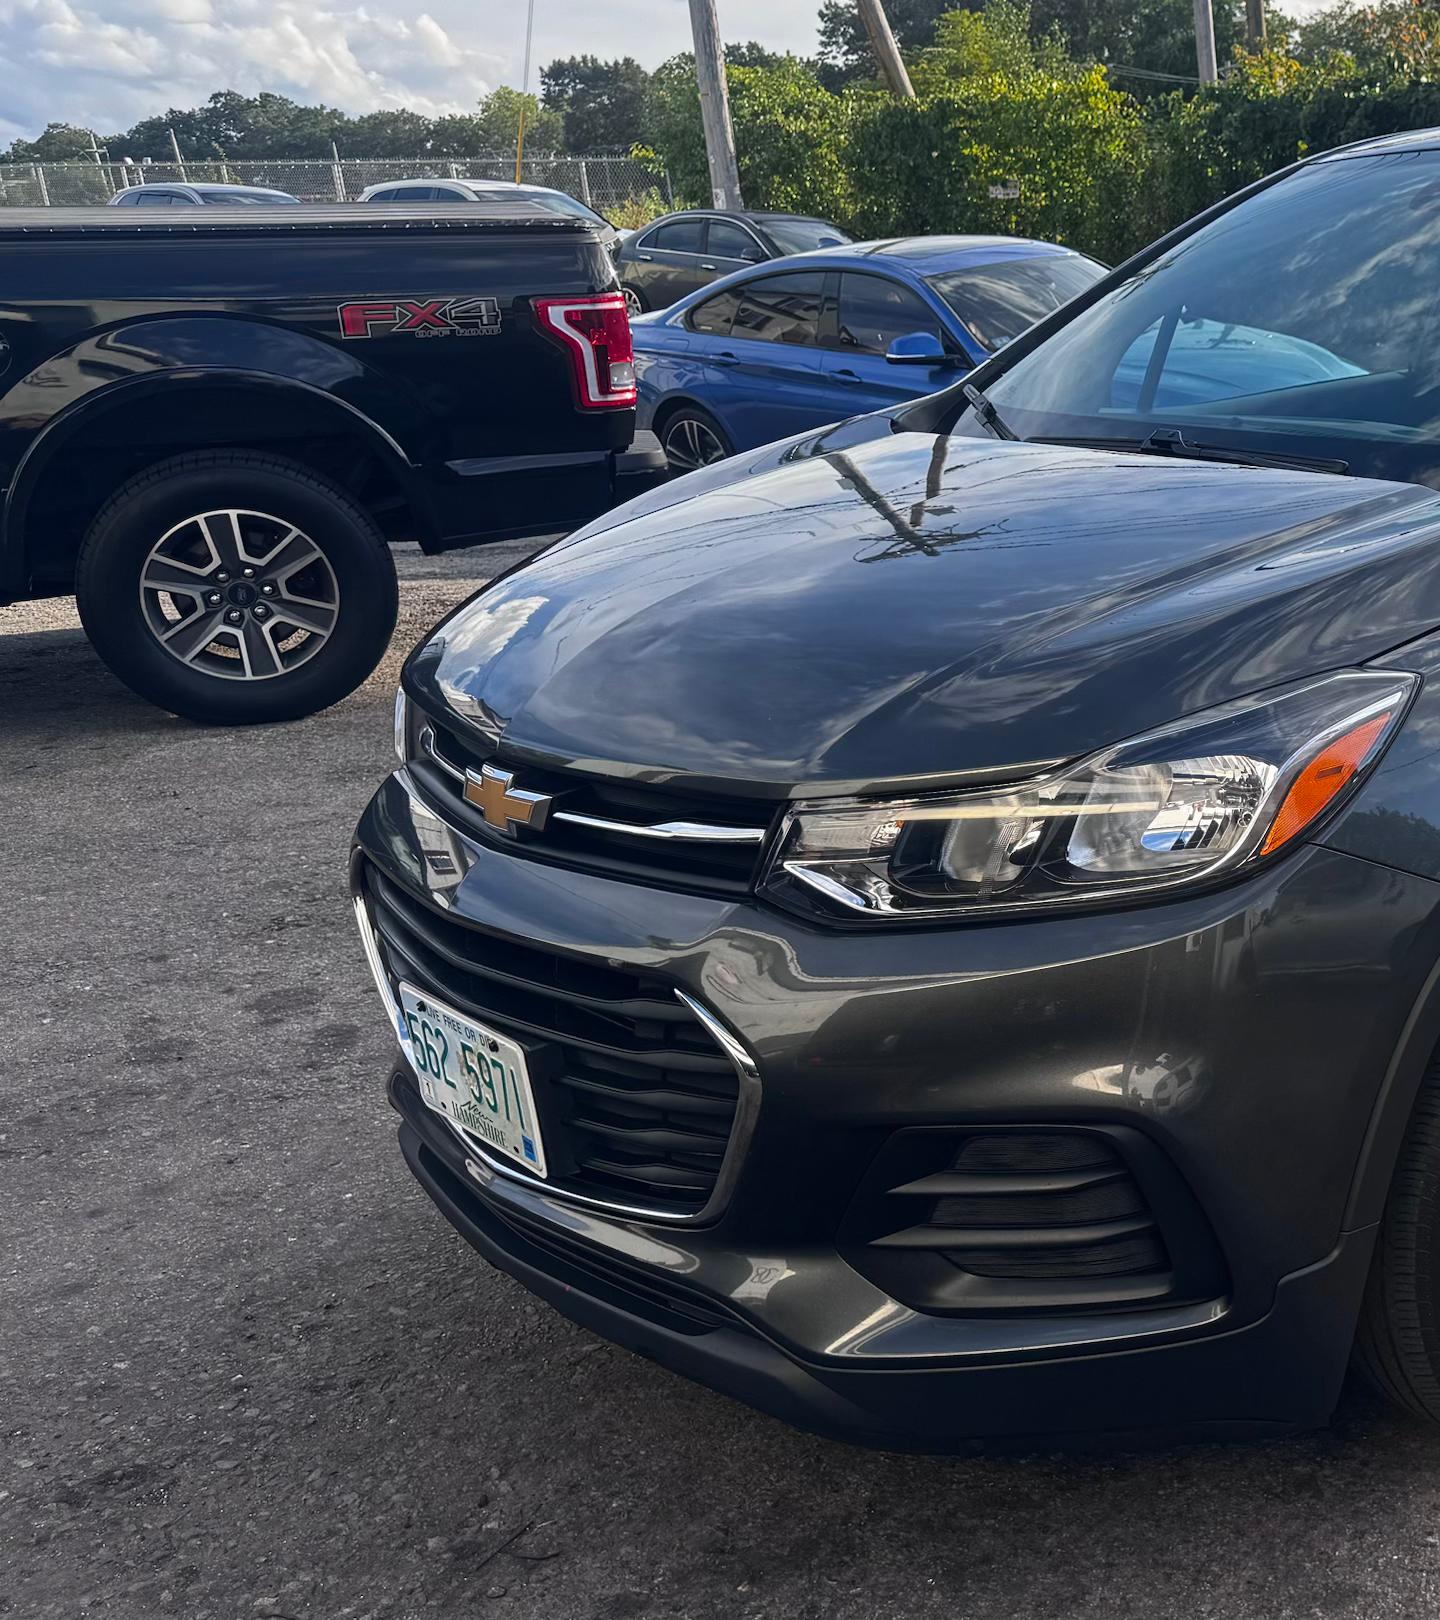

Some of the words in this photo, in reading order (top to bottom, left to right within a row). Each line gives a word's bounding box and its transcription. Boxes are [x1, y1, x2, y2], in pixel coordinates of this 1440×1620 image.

[337, 297, 501, 339] FX4
[414, 329, 450, 338] OFF
[456, 327, 502, 337] ROAD
[426, 1007, 441, 1023] LIVE
[443, 1014, 463, 1035] FREE
[464, 1026, 477, 1042] OR
[406, 1011, 457, 1090] 562
[460, 1039, 526, 1131] 5971
[451, 1100, 506, 1147] HAMPSHIRE
[460, 1100, 494, 1123] New
